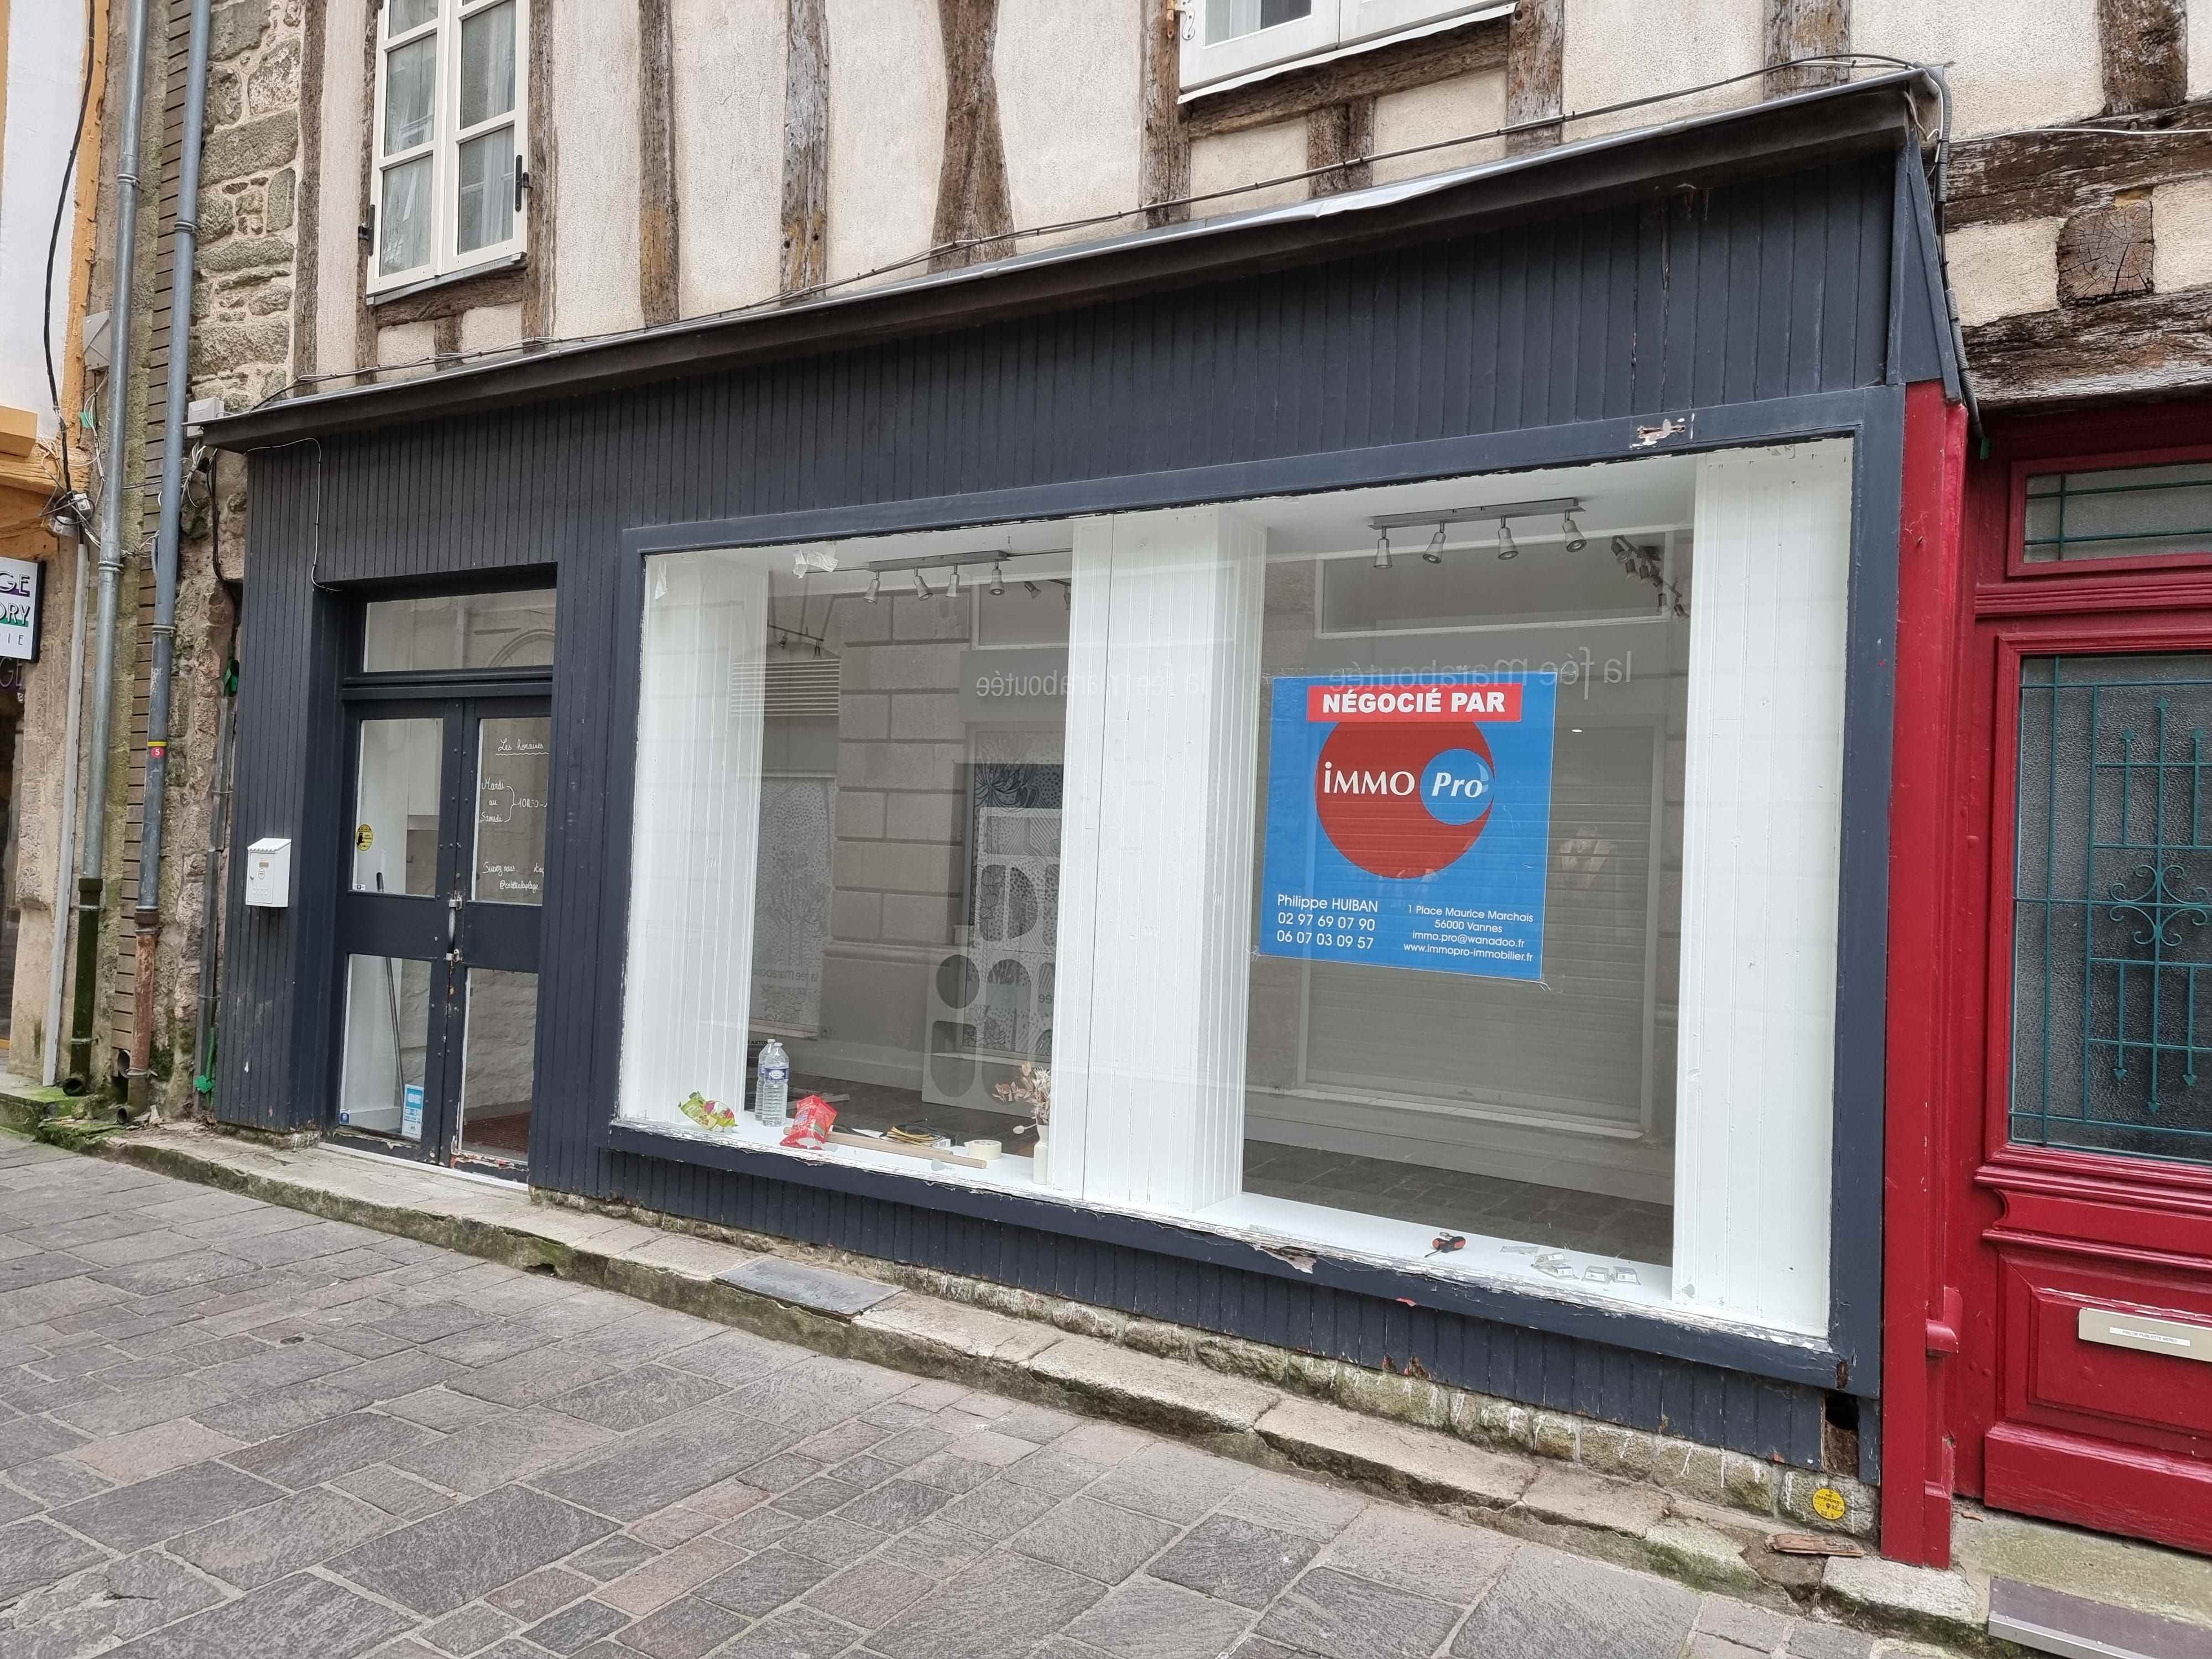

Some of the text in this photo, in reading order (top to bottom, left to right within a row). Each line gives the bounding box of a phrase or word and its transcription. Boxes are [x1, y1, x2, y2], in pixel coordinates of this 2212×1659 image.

[1323, 688, 1505, 713] NÉGOCIÉ PAR
[498, 738, 512, 752] Les
[482, 776, 505, 790] Mardi
[1324, 761, 1483, 798] iMMO Pro
[479, 811, 504, 823] Samedi
[1277, 894, 1378, 912] Philippe HUIBAN
[1278, 912, 1375, 931] 02 97 69 07 90
[1408, 905, 1533, 922] 1 Place Maurice Marchais
[1434, 920, 1503, 933] 56000 Vannes
[1277, 930, 1374, 949] 06 07 03 09 57
[1412, 930, 1525, 948] immo.pro@wanadoo.fr
[1404, 943, 1534, 962] www.immopro-immobilier.fr
